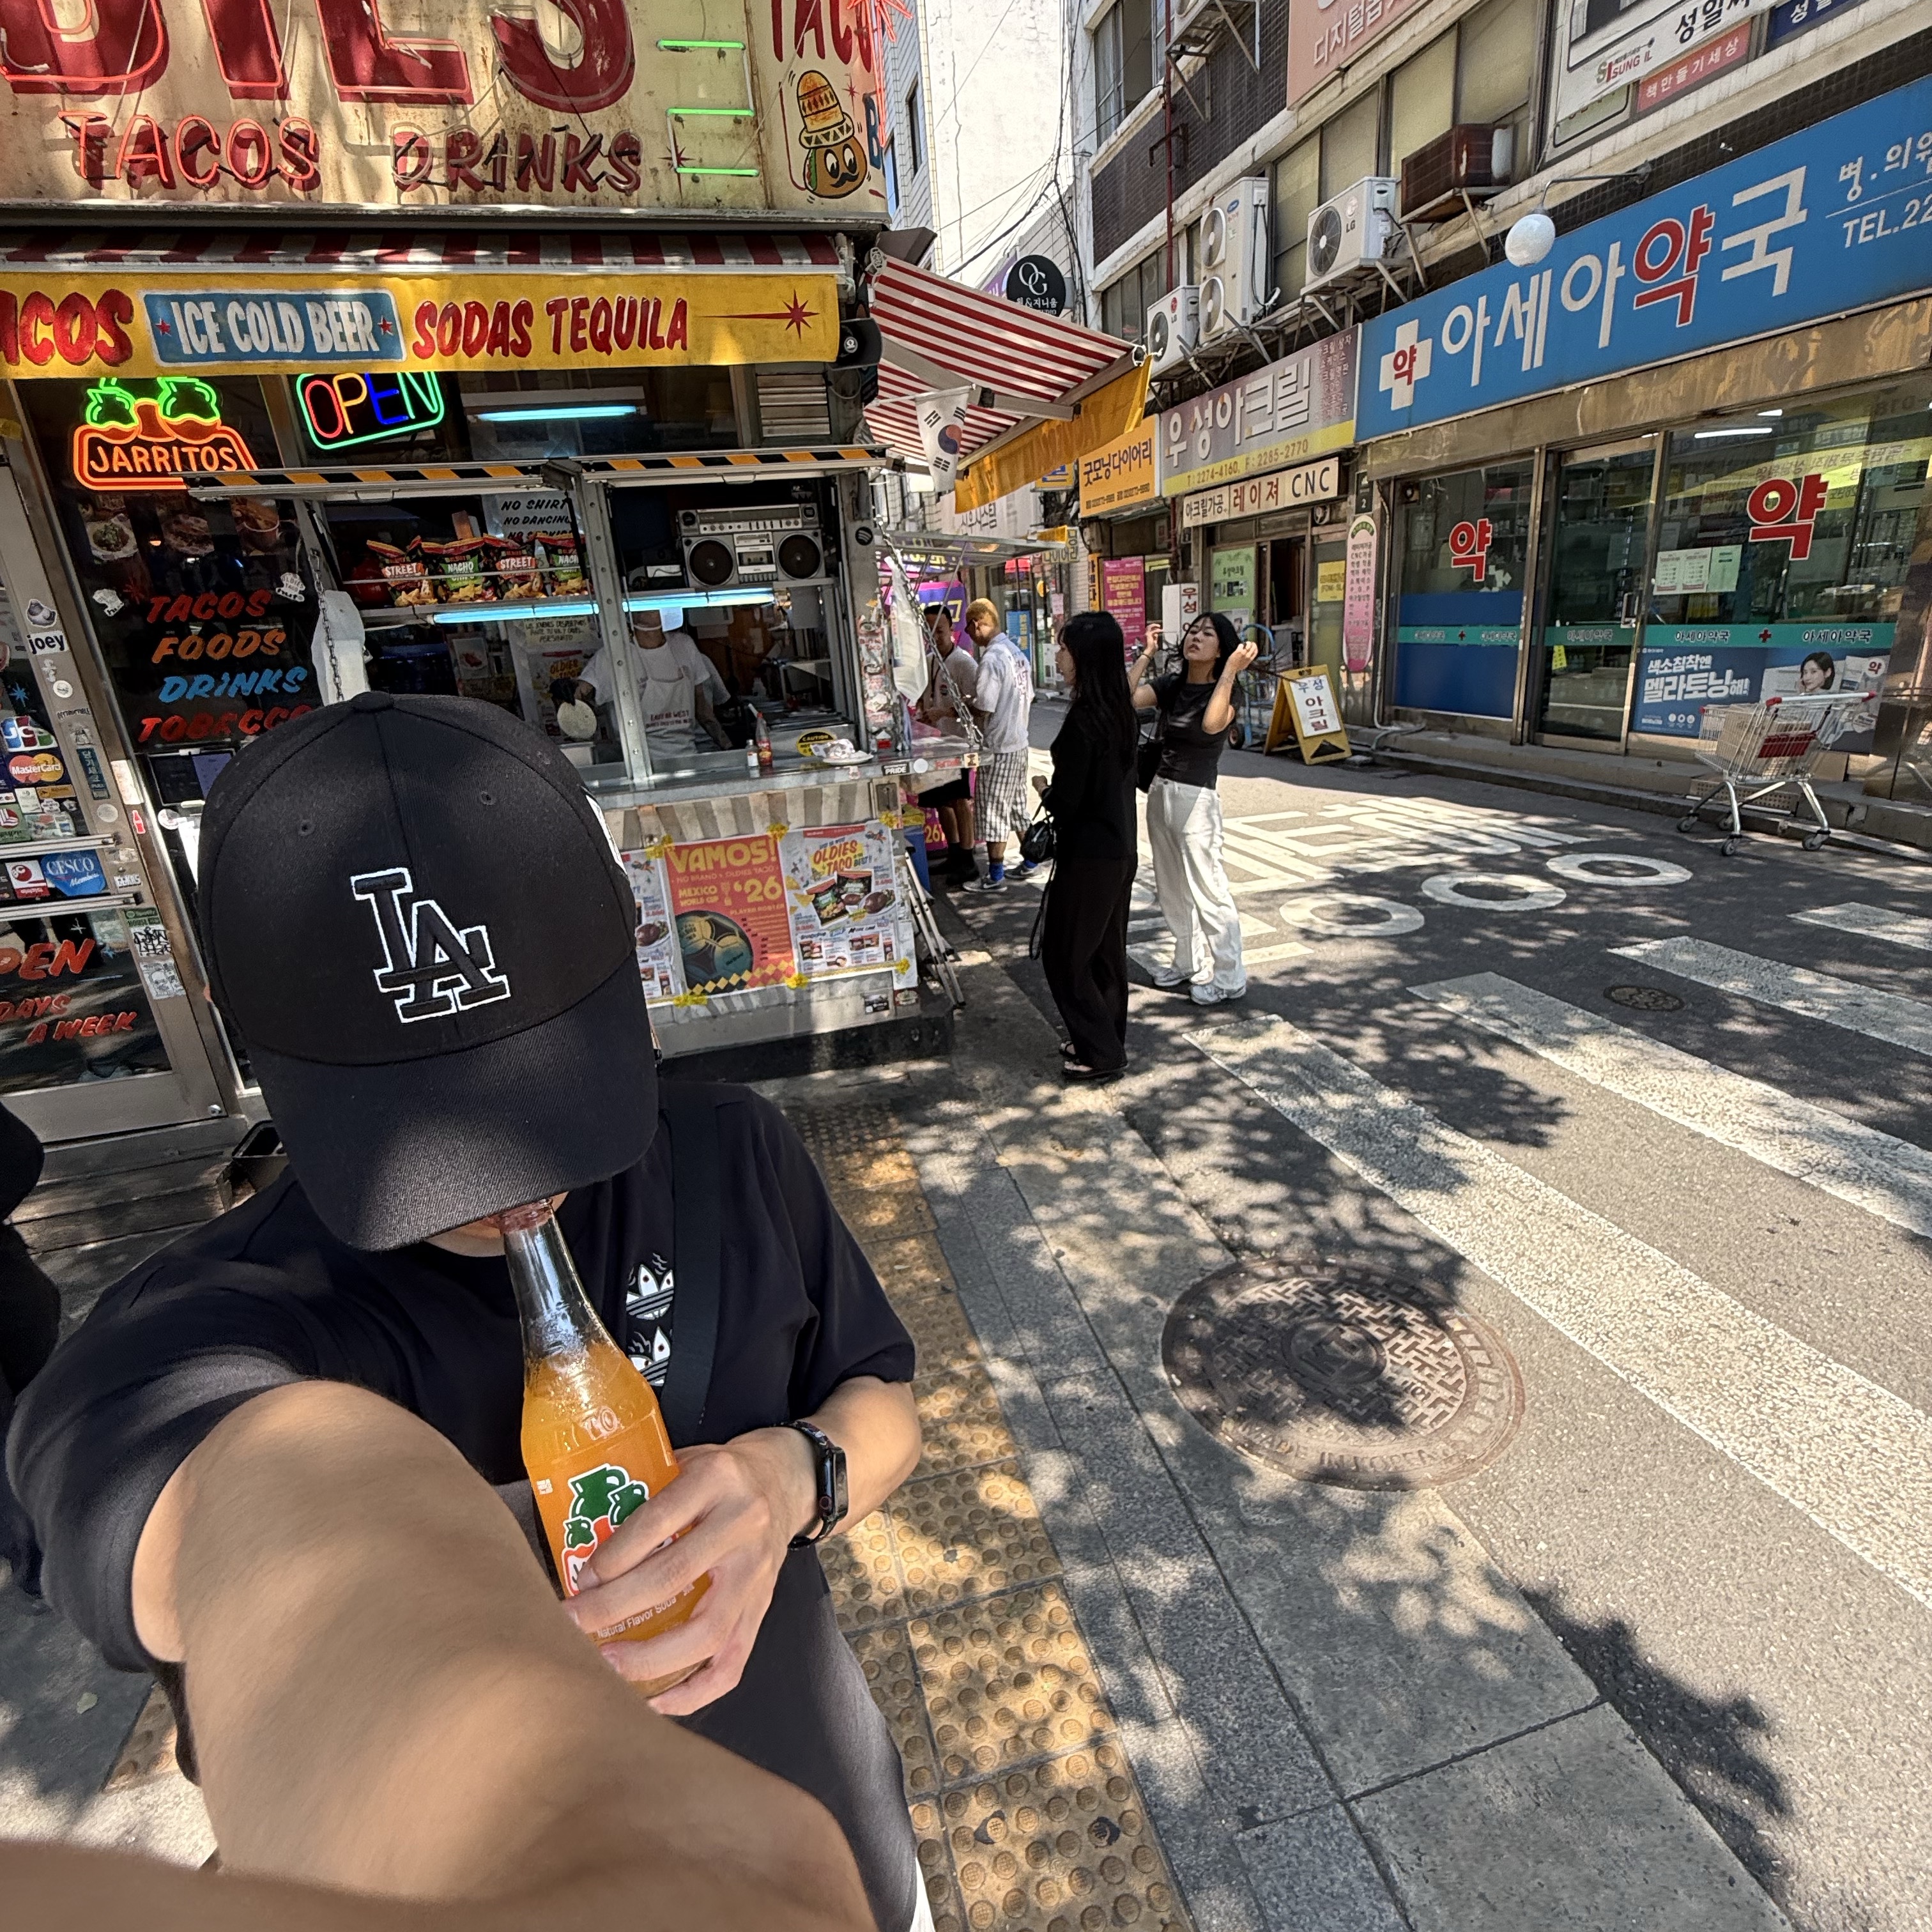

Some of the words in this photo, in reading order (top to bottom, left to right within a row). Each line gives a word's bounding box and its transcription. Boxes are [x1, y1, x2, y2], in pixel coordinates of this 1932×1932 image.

[59, 113, 321, 190] TACOS
[391, 123, 642, 196] DRINKS
[1346, 220, 1356, 233] LG
[1441, 166, 1808, 387] 아세아약국
[171, 302, 222, 355] ICE
[227, 301, 305, 354] COLD
[308, 301, 379, 353] BEER
[411, 300, 533, 358] SODAS
[546, 296, 688, 356] TEQUILA
[1393, 344, 1417, 386] 약
[305, 372, 438, 438] OPEN
[1167, 358, 1310, 468] 우성아크릴
[90, 445, 238, 473] JARRITOS
[1084, 438, 1152, 487] 굿모닝다이어리
[1292, 467, 1330, 498] CNC
[501, 500, 521, 511] NO
[526, 498, 567, 510] SHIRT
[1747, 473, 1830, 560] 약
[503, 516, 519, 526] NO
[500, 556, 532, 571] STREET
[1448, 518, 1492, 582] 약
[385, 563, 417, 576] STREET
[448, 561, 473, 572] NACHO
[146, 589, 272, 623] TACOS
[28, 633, 66, 654] joey
[151, 629, 286, 663] FOODS
[1675, 629, 1730, 643] 아세아약국
[1803, 629, 1872, 645] 아세아약국
[1647, 654, 1713, 675] 색소침착엔
[1868, 661, 1882, 675] 약
[158, 666, 308, 703] DRINKS
[12, 763, 61, 775] MasterCard
[885, 766, 907, 774] PRIDE
[46, 856, 95, 875] CESCO
[668, 839, 777, 873] VAMOS!
[813, 839, 858, 865] OLDIES
[827, 857, 853, 875] TACO
[678, 885, 718, 898] MEXICO
[351, 868, 511, 1023] LA
[26, 1023, 48, 1045] A
[53, 1011, 137, 1041] WEEK
[596, 1620, 626, 1639] Natural
[627, 1609, 653, 1629] Flavor
